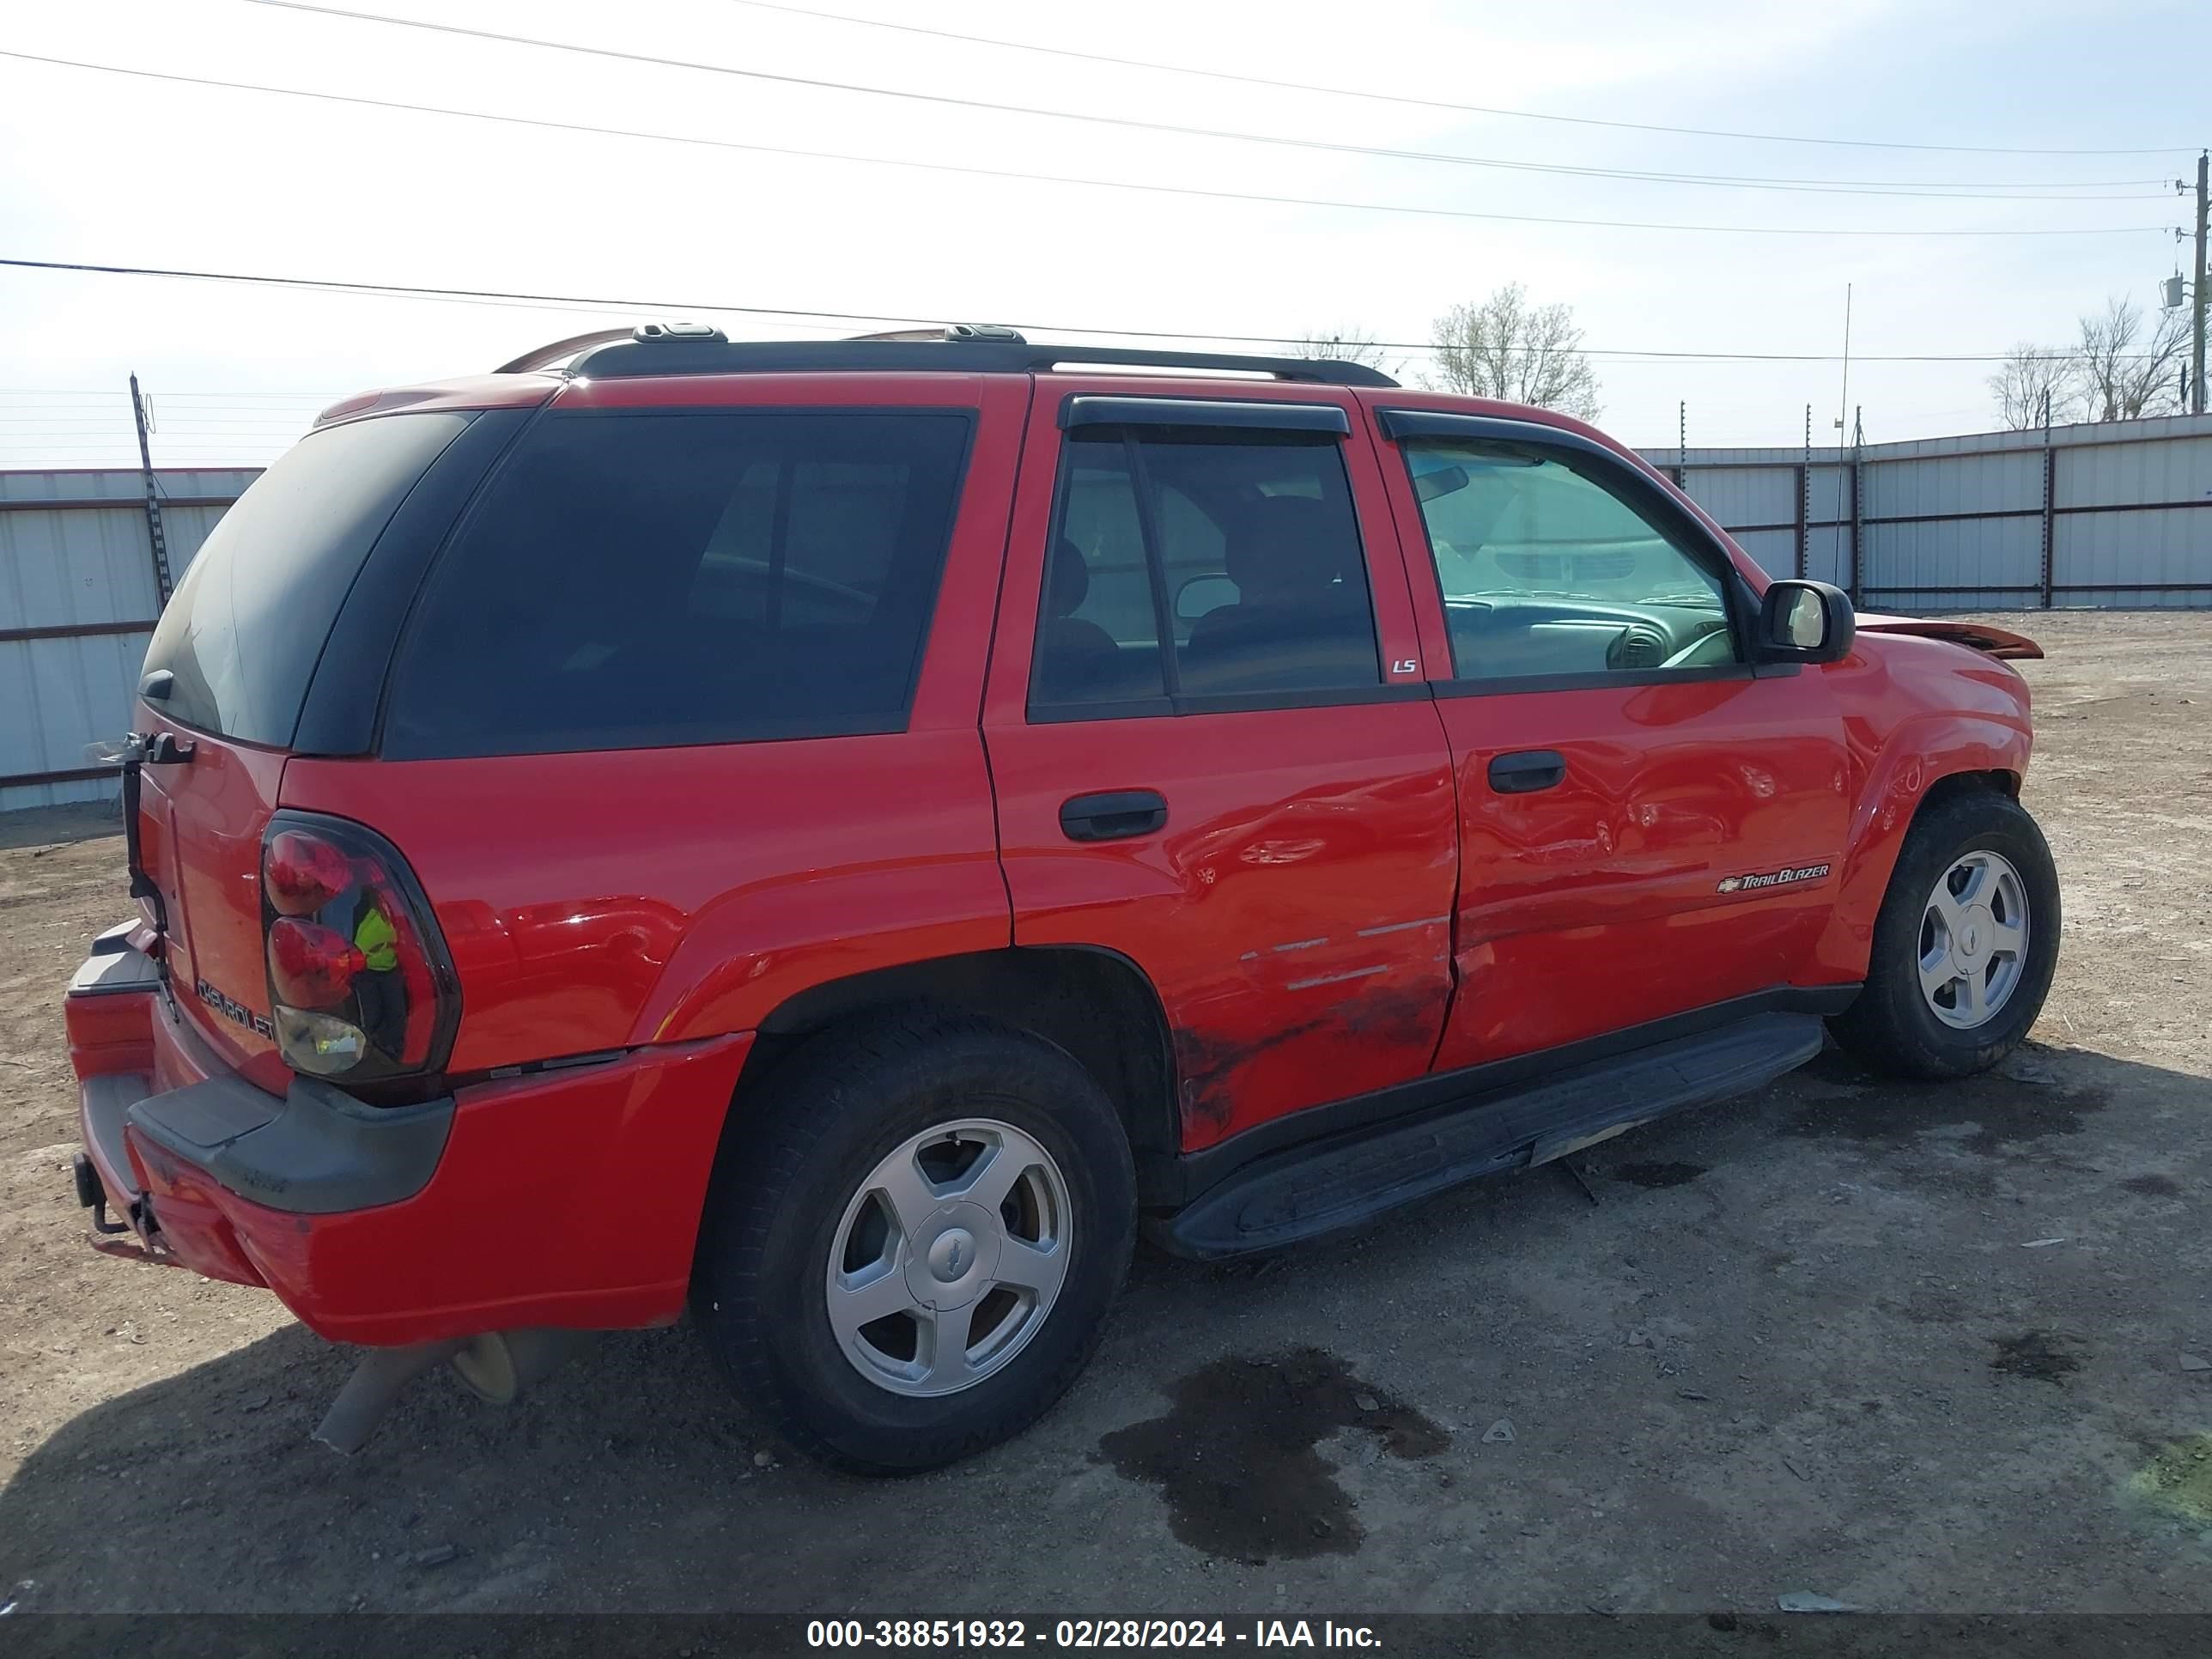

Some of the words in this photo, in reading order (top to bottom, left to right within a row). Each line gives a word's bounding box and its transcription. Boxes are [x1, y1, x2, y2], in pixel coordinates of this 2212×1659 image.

[1392, 659, 1417, 674] LS
[1741, 864, 1830, 890] TRAILBLAZER
[198, 978, 275, 1042] CHEVROLET
